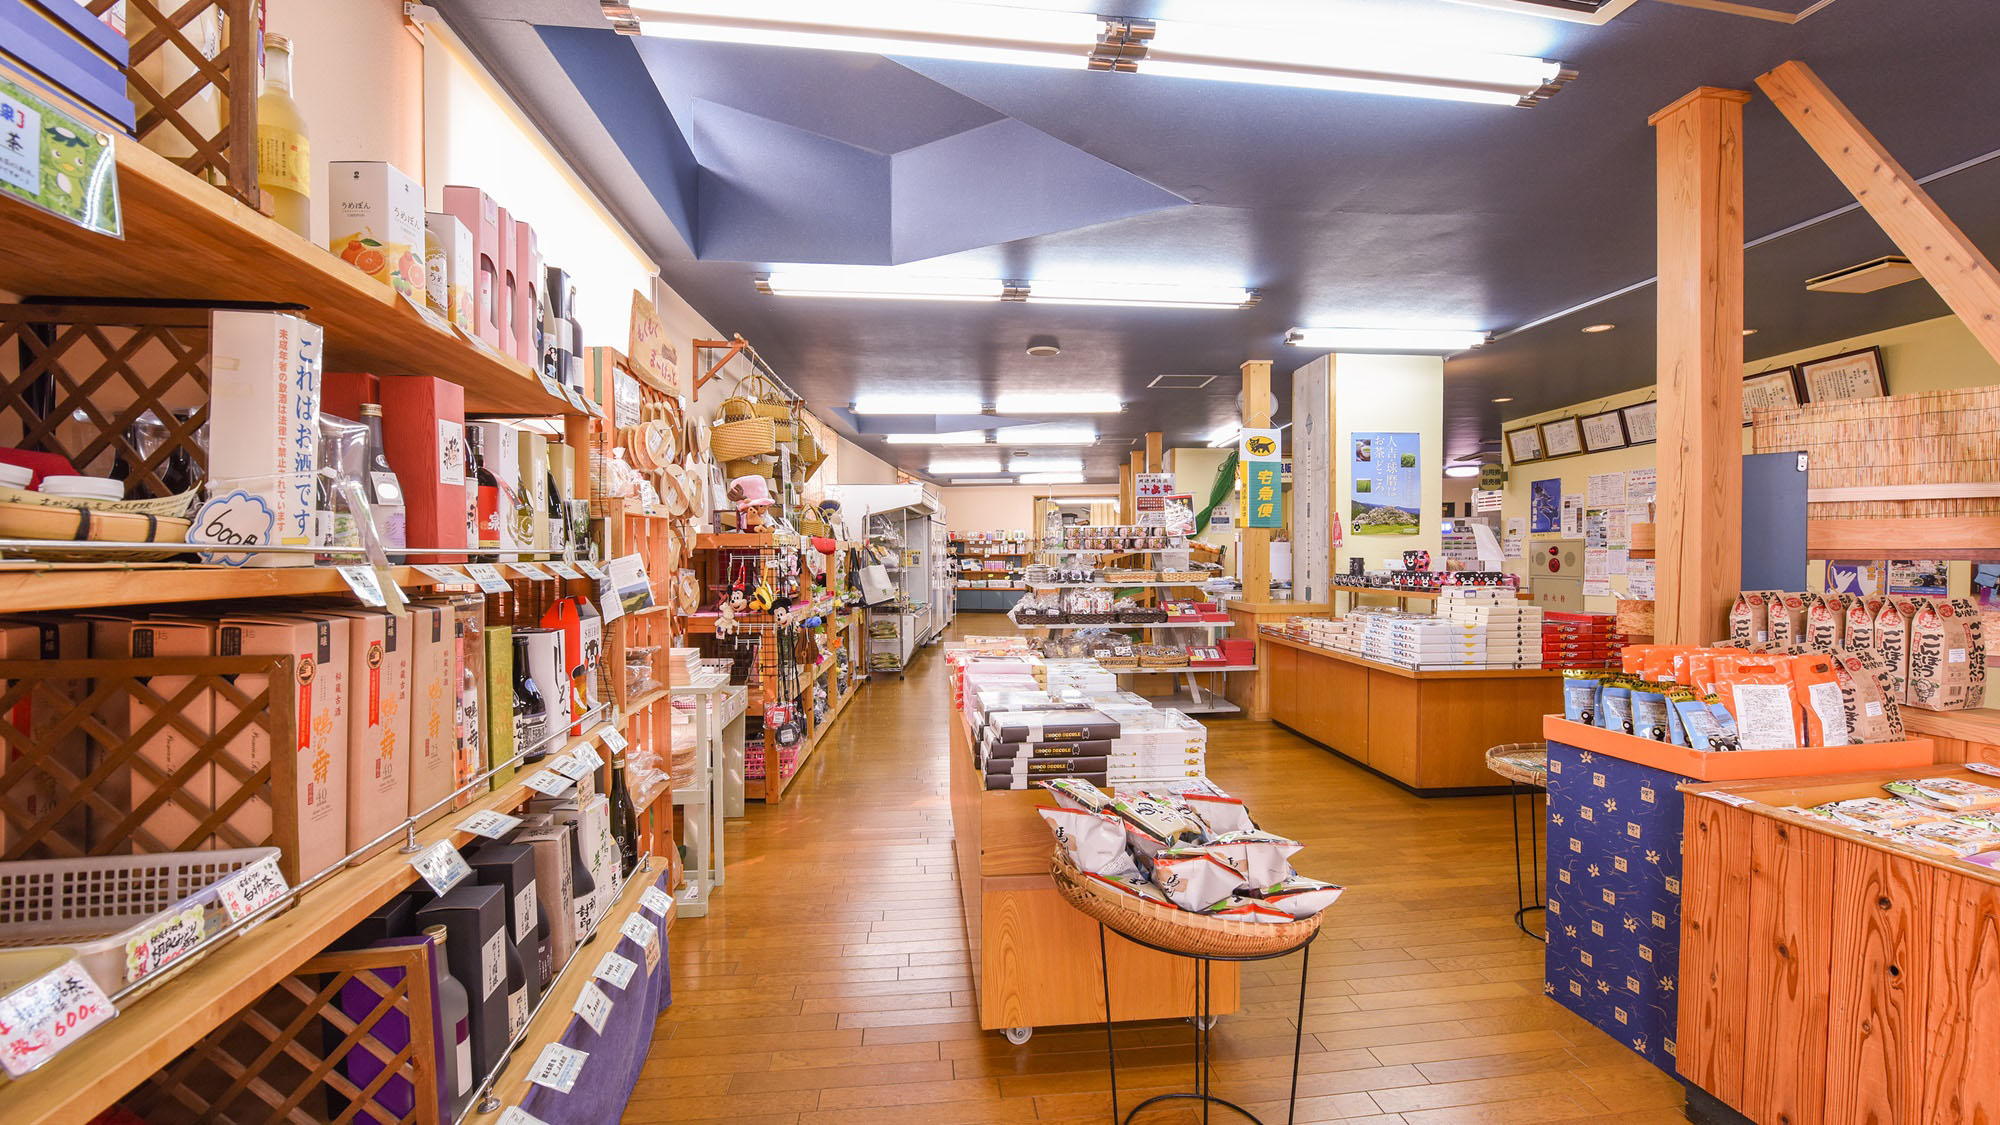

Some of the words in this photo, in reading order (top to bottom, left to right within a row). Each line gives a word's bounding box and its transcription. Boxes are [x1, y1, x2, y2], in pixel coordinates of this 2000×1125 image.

[294, 338, 313, 537] これはお酒です
[1257, 469, 1274, 518] 宅急便
[1952, 599, 1972, 609] 元気
